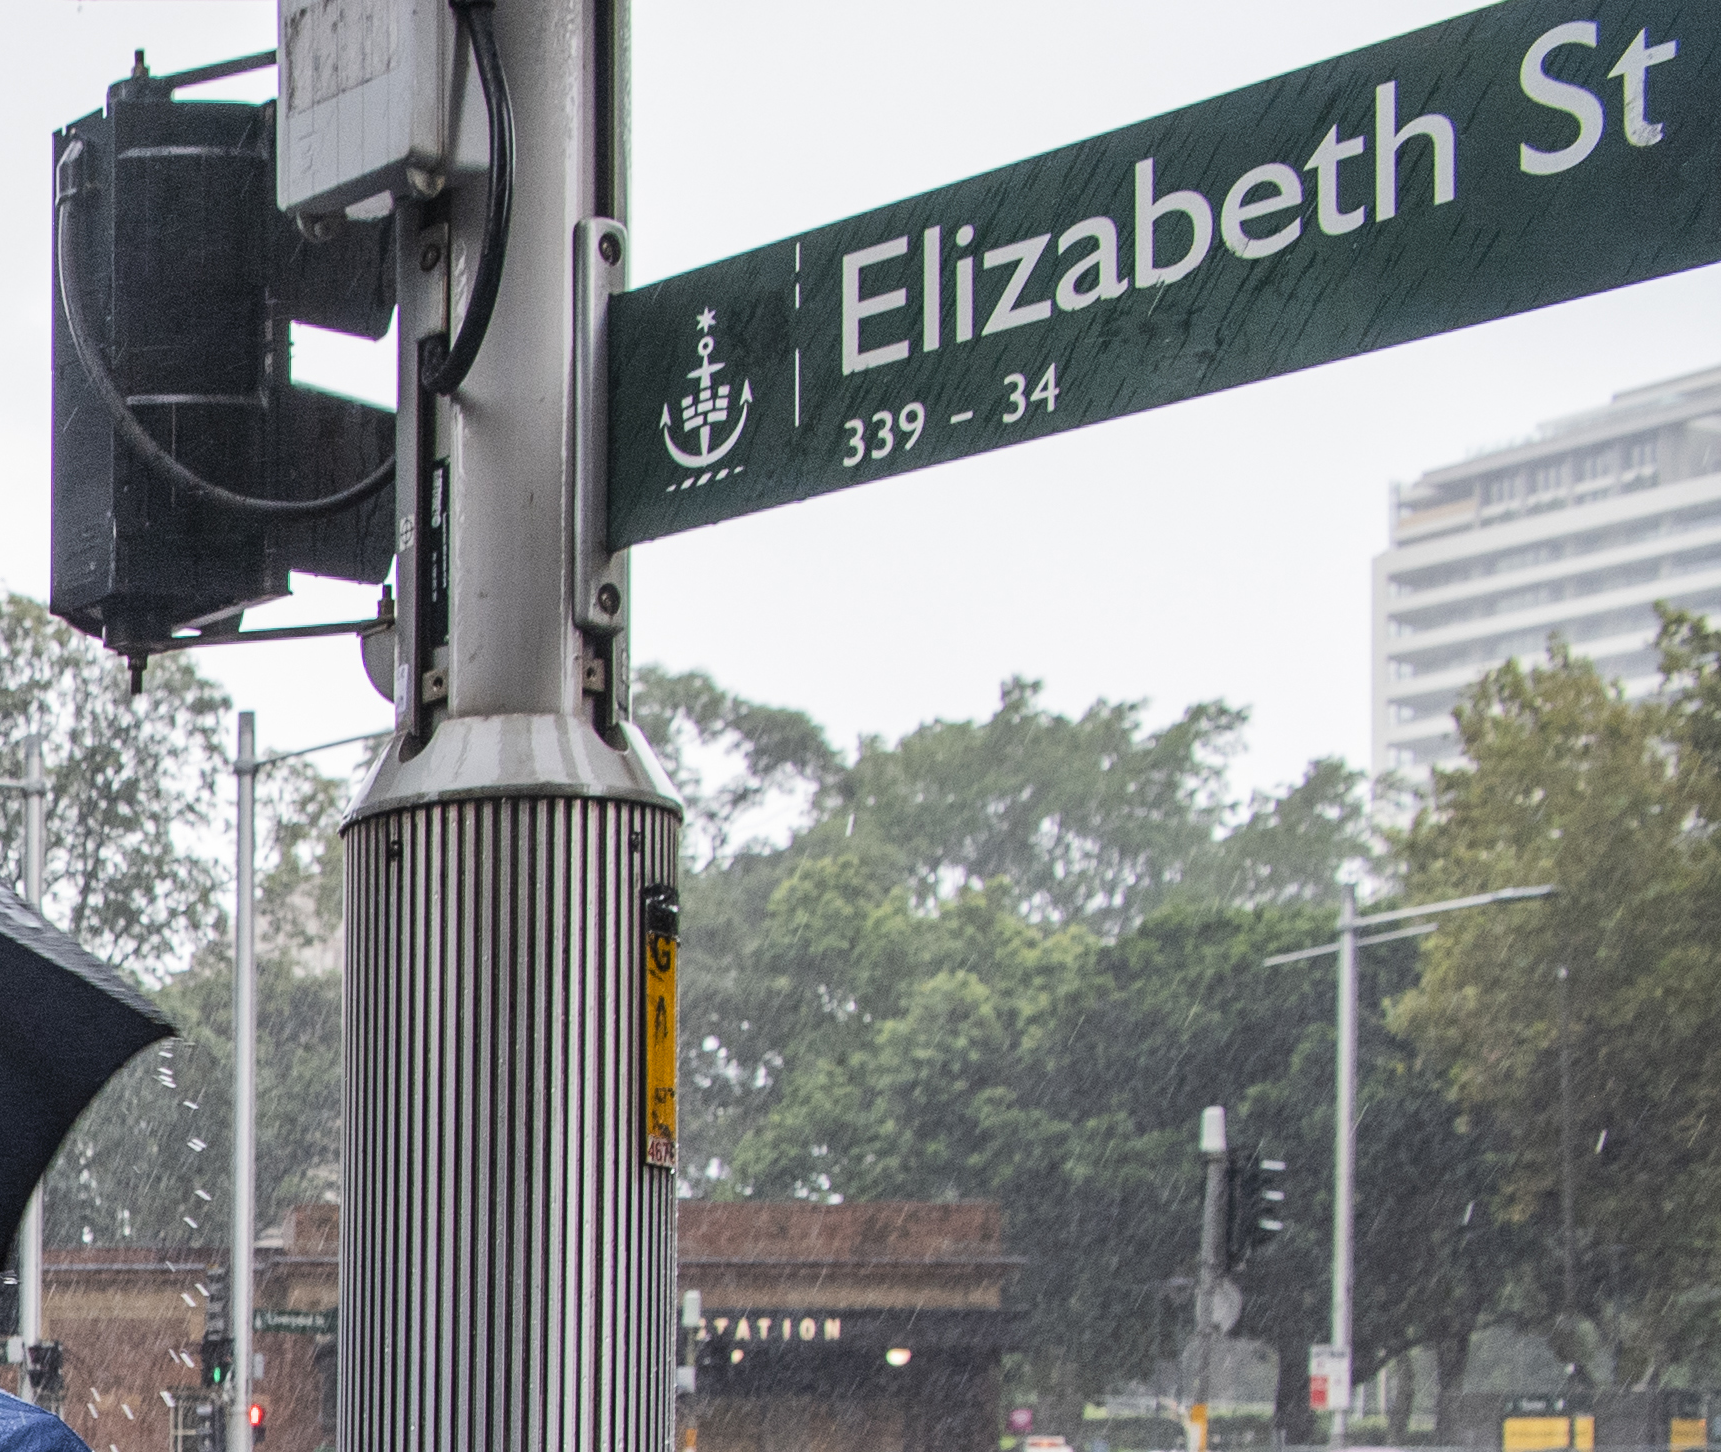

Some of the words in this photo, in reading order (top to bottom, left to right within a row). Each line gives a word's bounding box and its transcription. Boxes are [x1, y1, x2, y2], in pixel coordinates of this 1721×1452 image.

[841, 81, 1456, 376] Elizabeth
[1519, 20, 1678, 176] St
[843, 402, 925, 467] 339
[1003, 362, 1060, 424] 34
